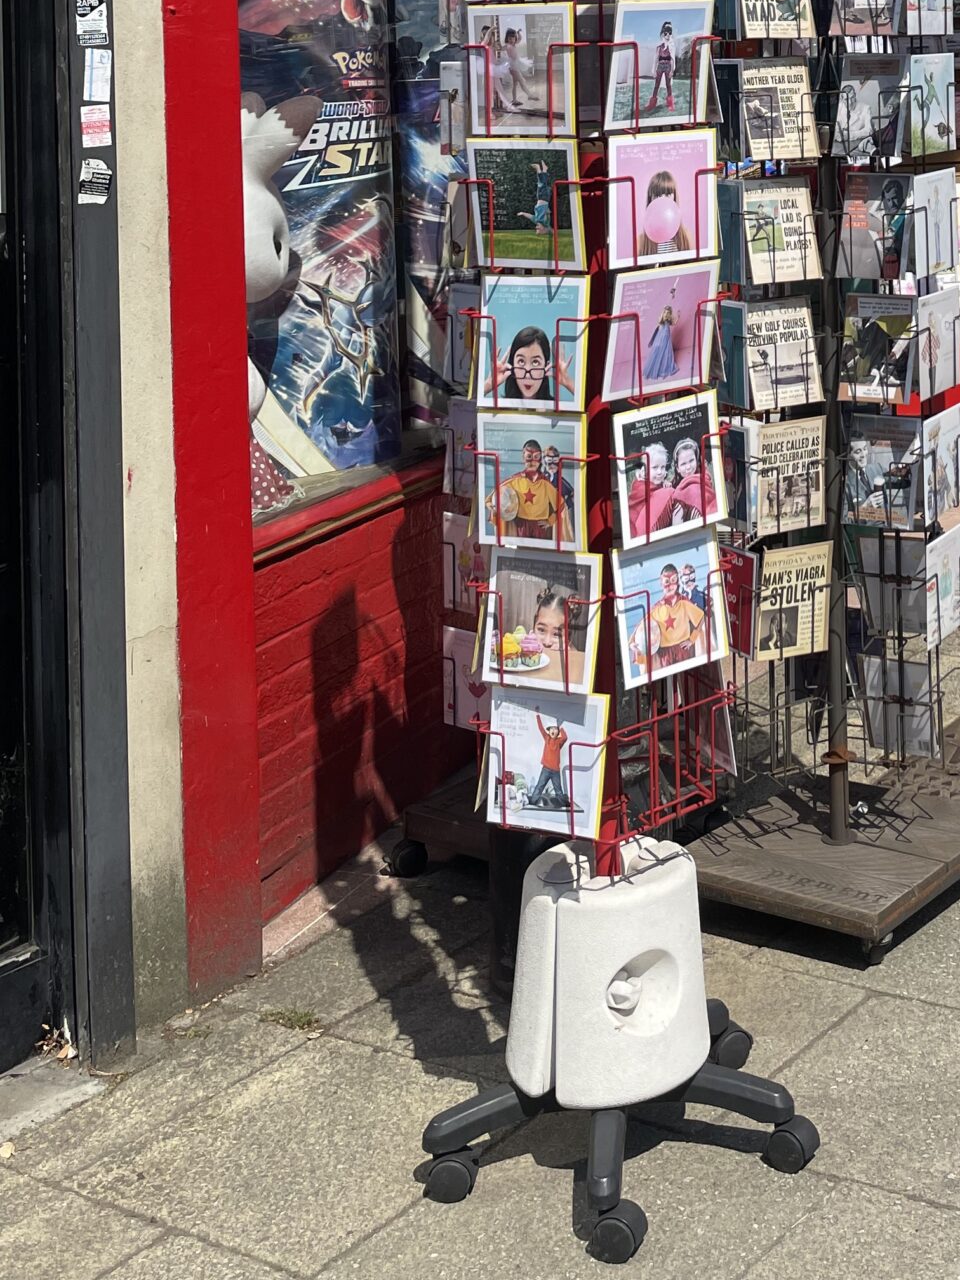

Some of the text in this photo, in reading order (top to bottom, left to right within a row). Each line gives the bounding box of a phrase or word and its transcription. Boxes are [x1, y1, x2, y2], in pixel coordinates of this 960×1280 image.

[76, 0, 100, 7] RAPID
[745, 2, 777, 22] MAD
[743, 74, 805, 87] ANOTHER YEAR OLDER
[780, 198, 799, 210] LOCAL
[781, 212, 803, 223] LAD IS
[783, 226, 803, 238] GOING
[785, 238, 812, 251] PLACES!
[747, 317, 808, 334] NEW GOLF COURSE
[748, 328, 809, 346] PROVING POPULAR
[762, 435, 820, 455] POLICE CALLED AS
[762, 447, 820, 466] WILD CELEBRATIONS
[761, 467, 775, 478] GET
[778, 463, 790, 476] OUT
[792, 462, 800, 474] OF
[763, 564, 826, 587] MAN'S VIAGRA
[769, 580, 817, 607] STOLEN
